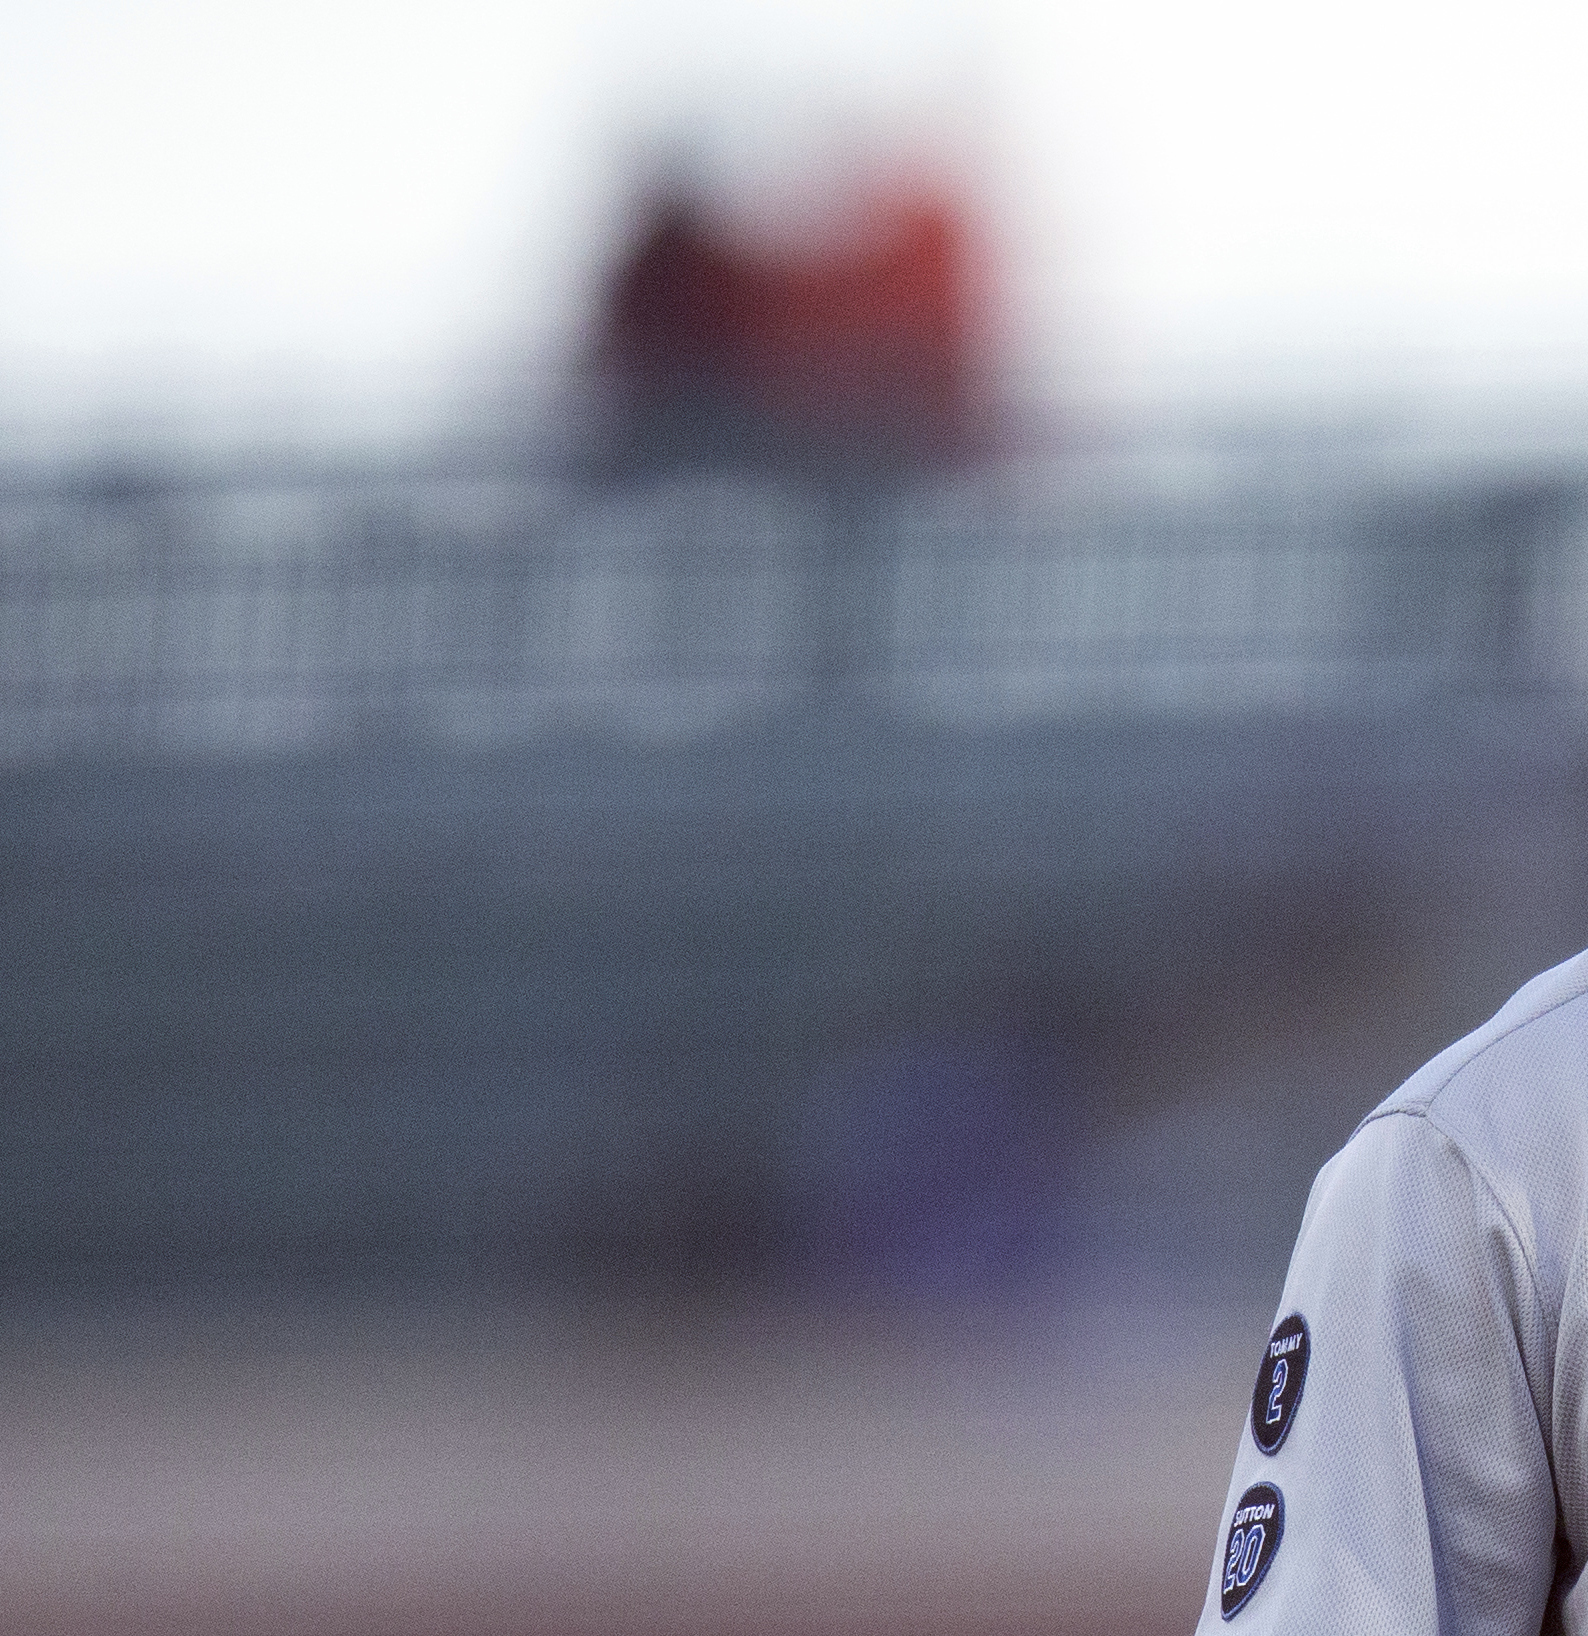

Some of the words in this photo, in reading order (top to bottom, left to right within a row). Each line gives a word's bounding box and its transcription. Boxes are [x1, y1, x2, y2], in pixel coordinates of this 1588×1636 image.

[1269, 1332, 1303, 1358] TOMMY
[1265, 1358, 1289, 1424] 2
[1233, 1503, 1275, 1528] SUTTON
[1223, 1524, 1266, 1595] 20
